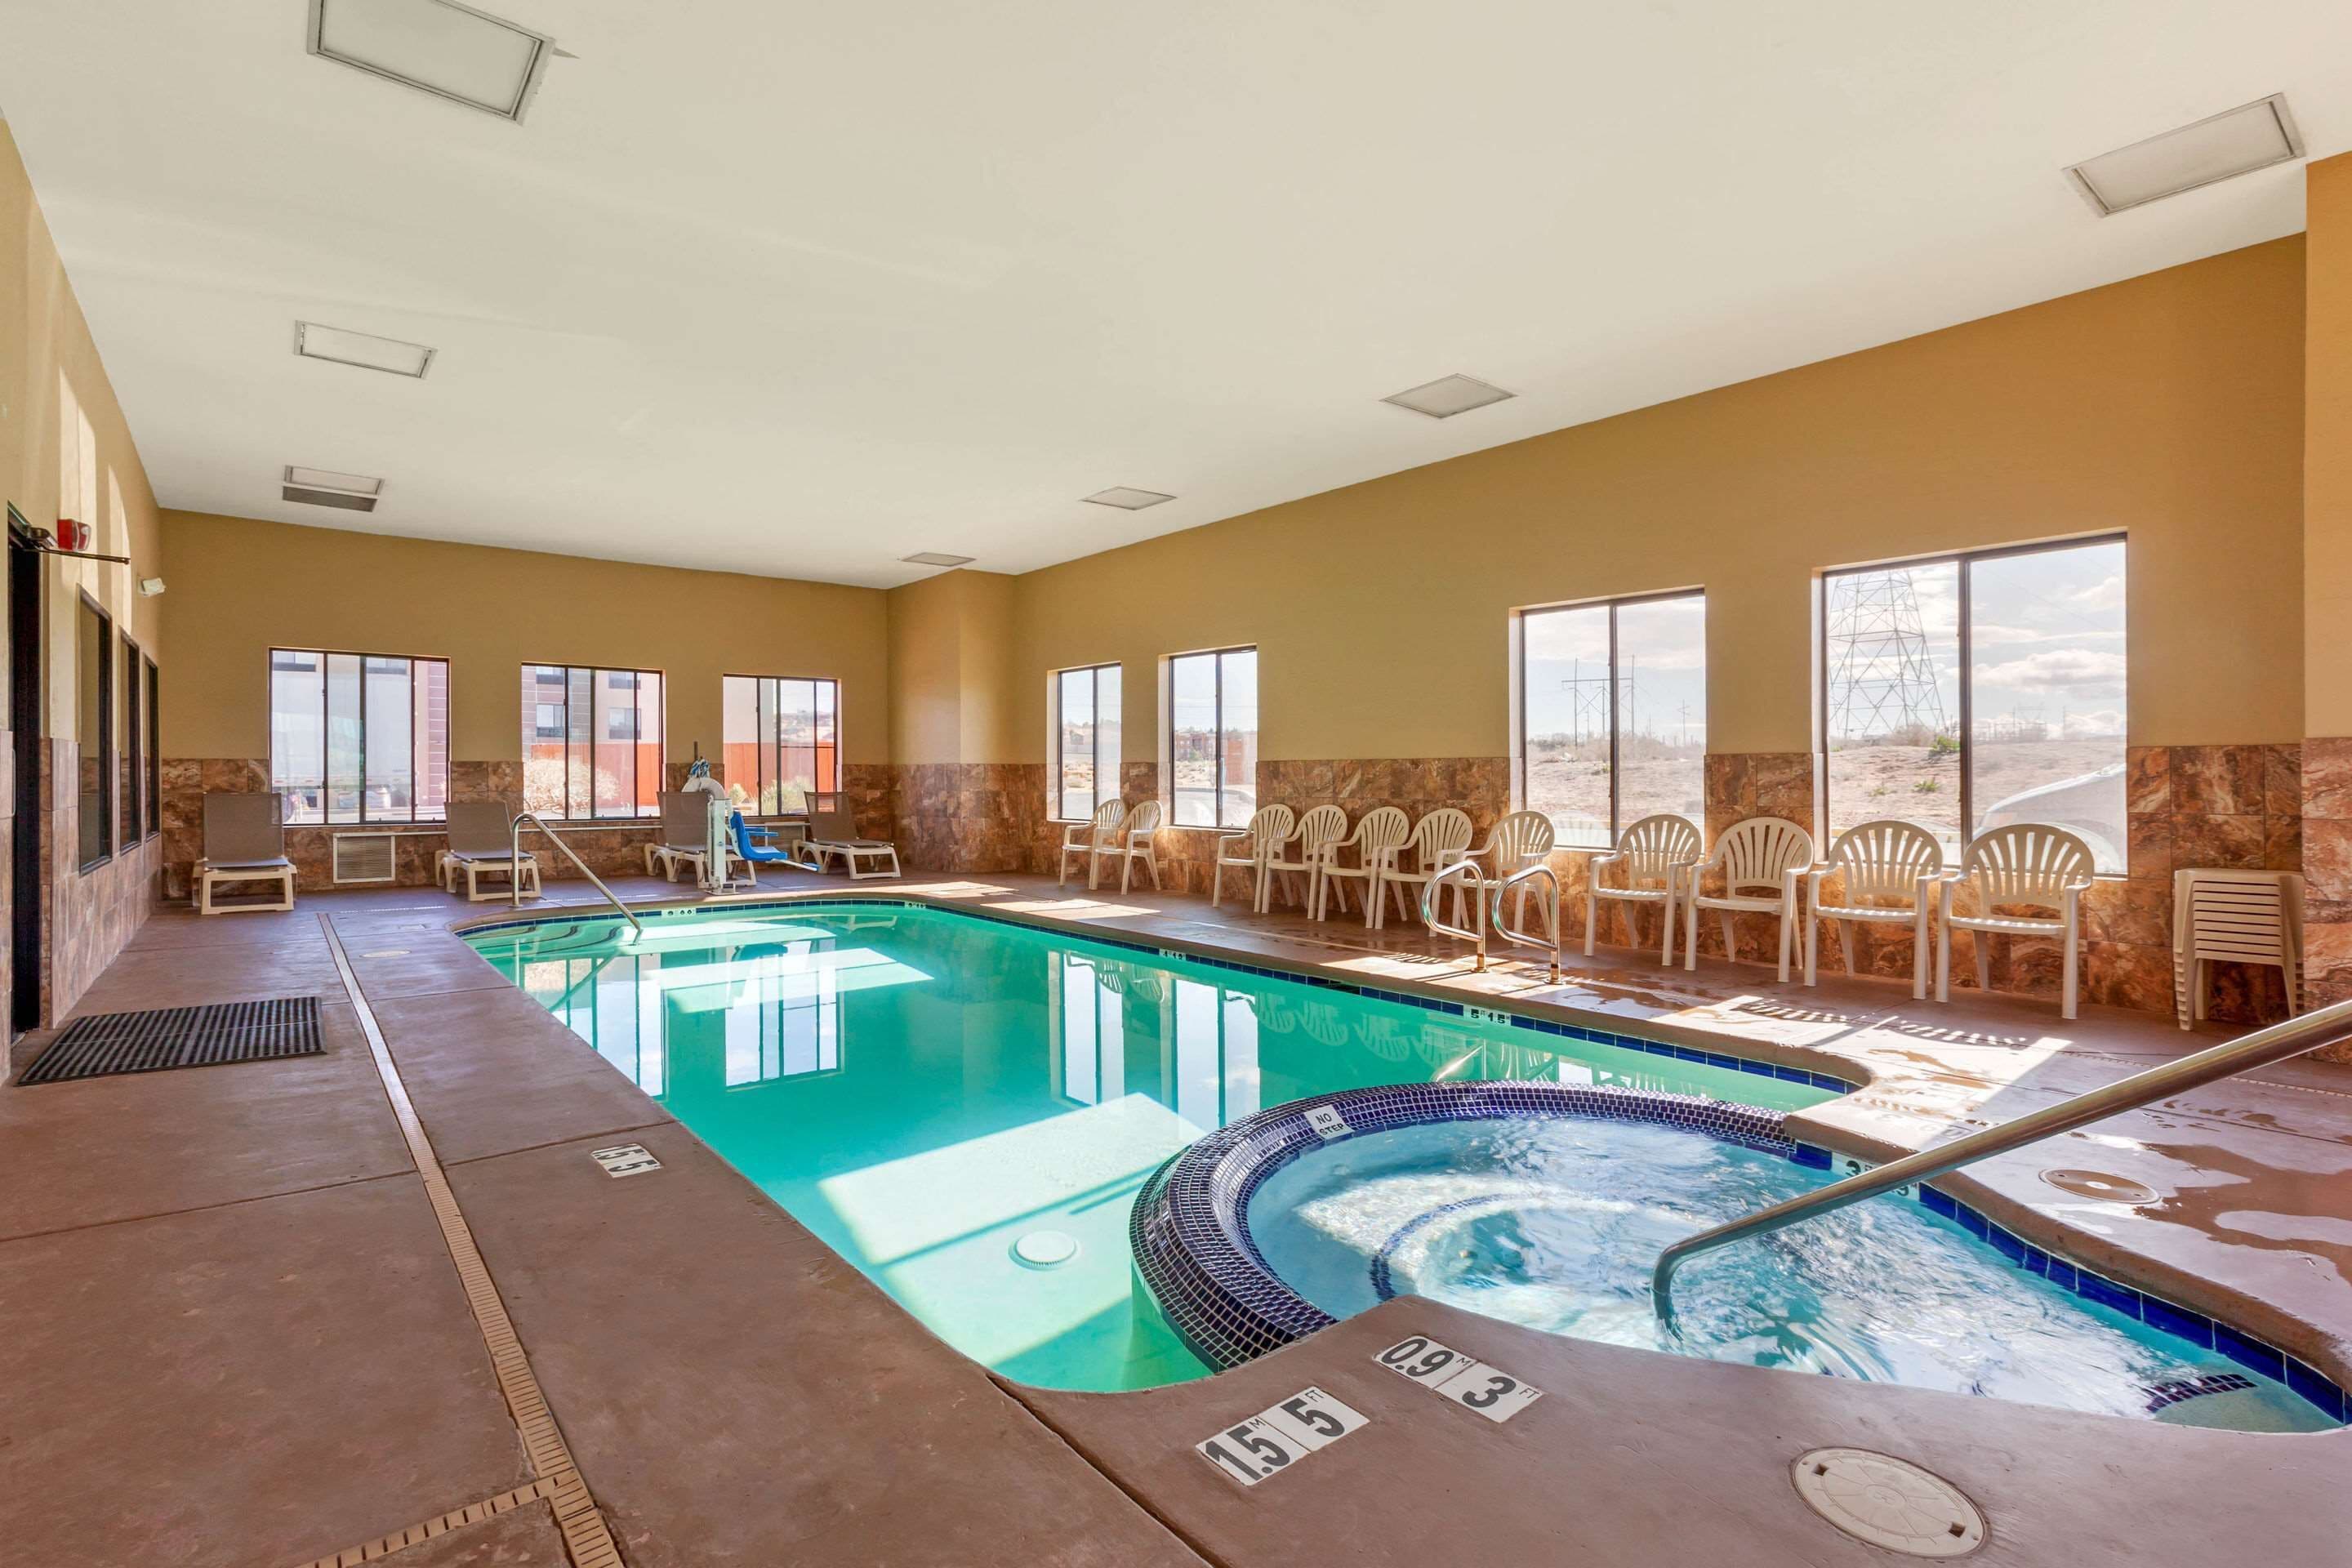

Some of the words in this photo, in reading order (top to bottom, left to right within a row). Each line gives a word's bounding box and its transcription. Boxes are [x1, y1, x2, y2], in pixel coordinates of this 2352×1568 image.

[1471, 1009, 1479, 1018] 5
[1315, 1113, 1332, 1125] NO
[1319, 1123, 1344, 1135] STEP
[608, 1160, 657, 1172] 5
[1381, 1339, 1454, 1377] 0.9
[1456, 1356, 1471, 1366] M
[1304, 1389, 1325, 1403] FT
[1462, 1376, 1517, 1408] 3
[1518, 1387, 1540, 1399] FT
[1280, 1397, 1345, 1437] 5
[1248, 1418, 1267, 1429] M
[1205, 1424, 1290, 1481] 1.5
